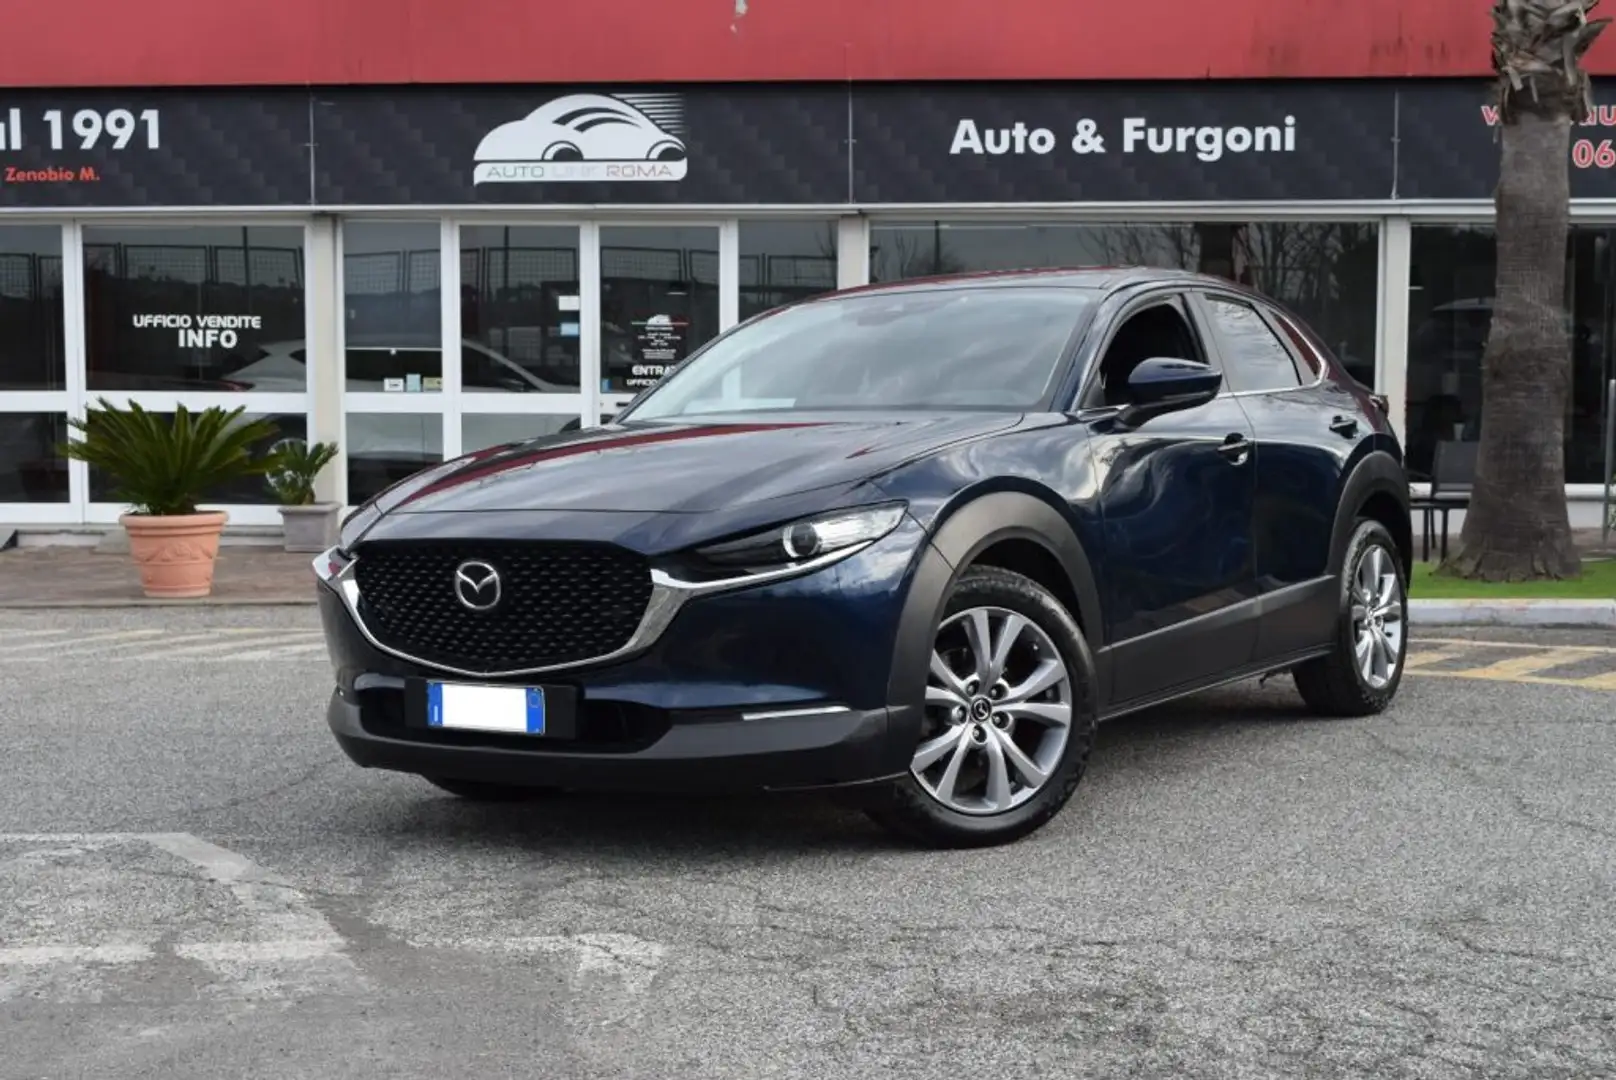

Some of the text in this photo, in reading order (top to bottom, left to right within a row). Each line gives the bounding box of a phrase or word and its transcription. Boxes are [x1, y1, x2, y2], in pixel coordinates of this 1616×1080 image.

[43, 108, 160, 150] 1991
[949, 115, 1296, 162] Auto & Furgoni
[5, 166, 100, 182] Zenobio M.
[486, 165, 545, 178] AUTO
[606, 164, 673, 177] ROMA
[133, 314, 262, 329] UFFICIO VENDITE
[178, 329, 238, 348] INFO
